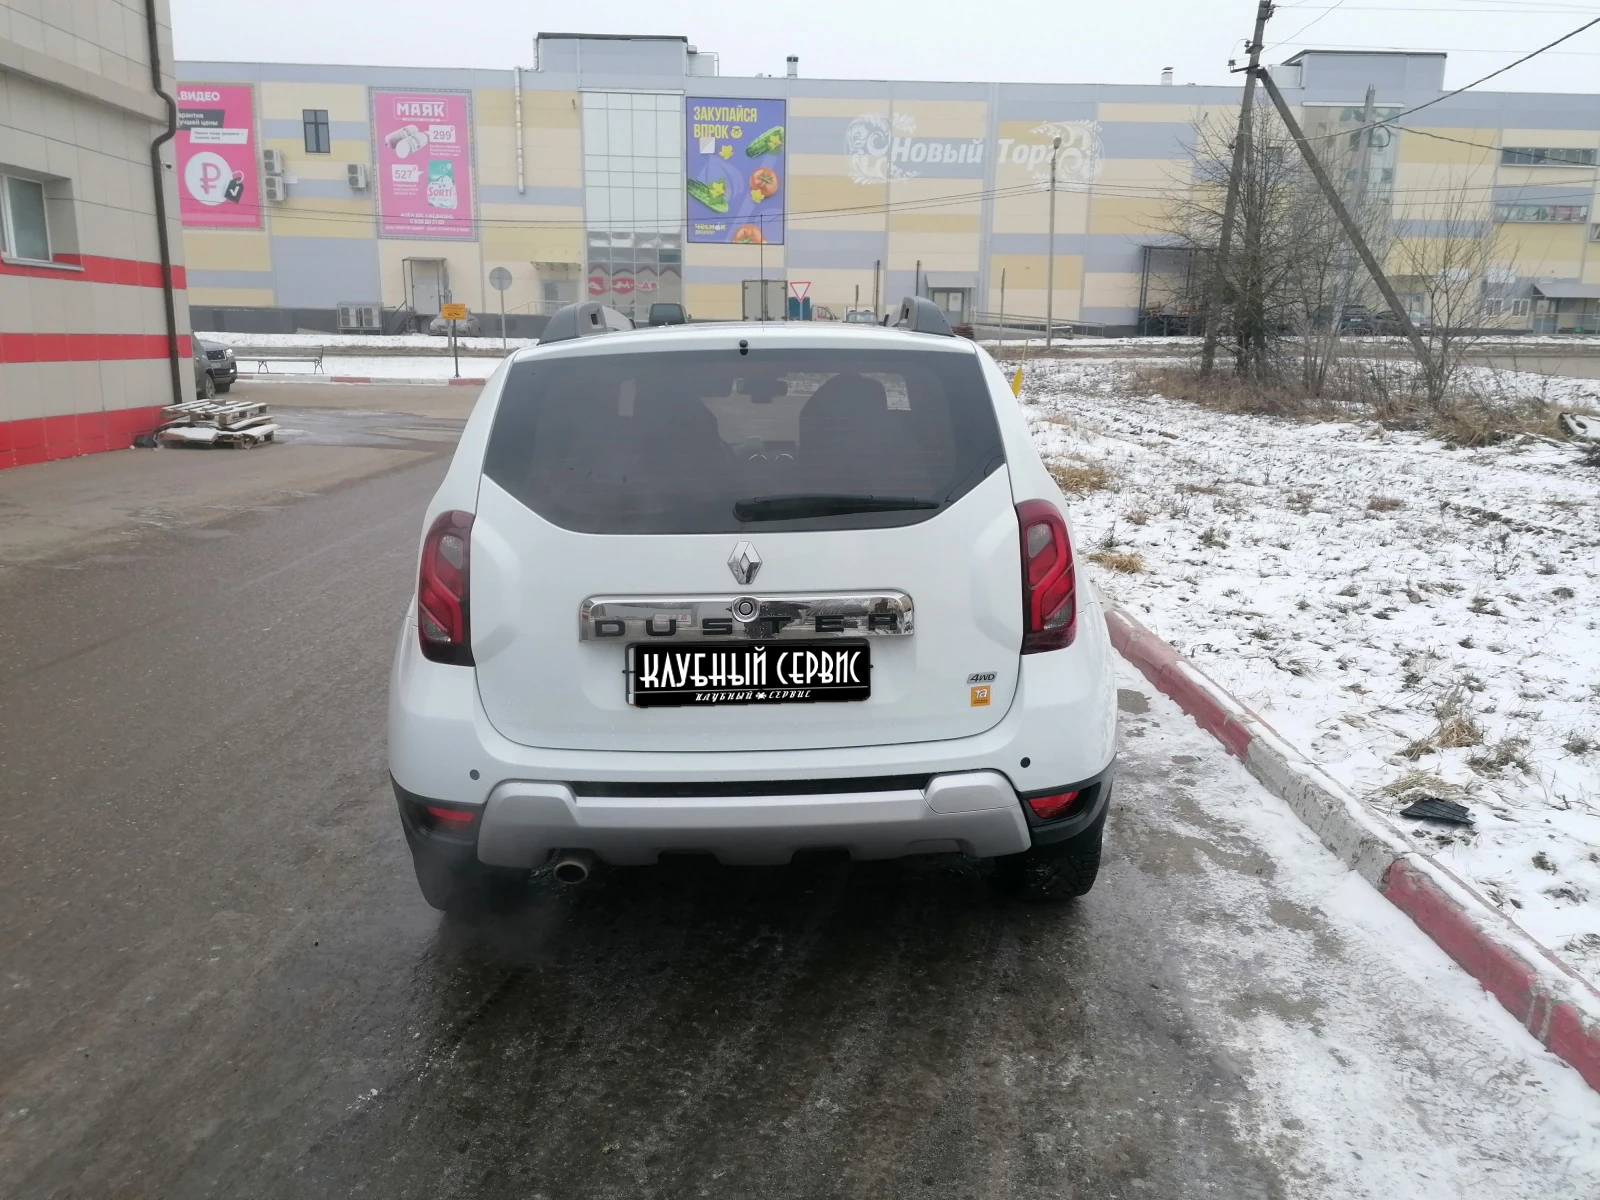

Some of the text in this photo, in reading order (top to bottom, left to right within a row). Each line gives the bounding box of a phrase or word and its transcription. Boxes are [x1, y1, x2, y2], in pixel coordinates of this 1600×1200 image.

[396, 102, 445, 117] МАЯК
[693, 105, 757, 122] ЗАКУПАЙСЯ
[693, 123, 729, 139] ВПРОК
[891, 137, 984, 164] Новый
[594, 613, 899, 637] DUSTER
[970, 673, 995, 682] 4WD
